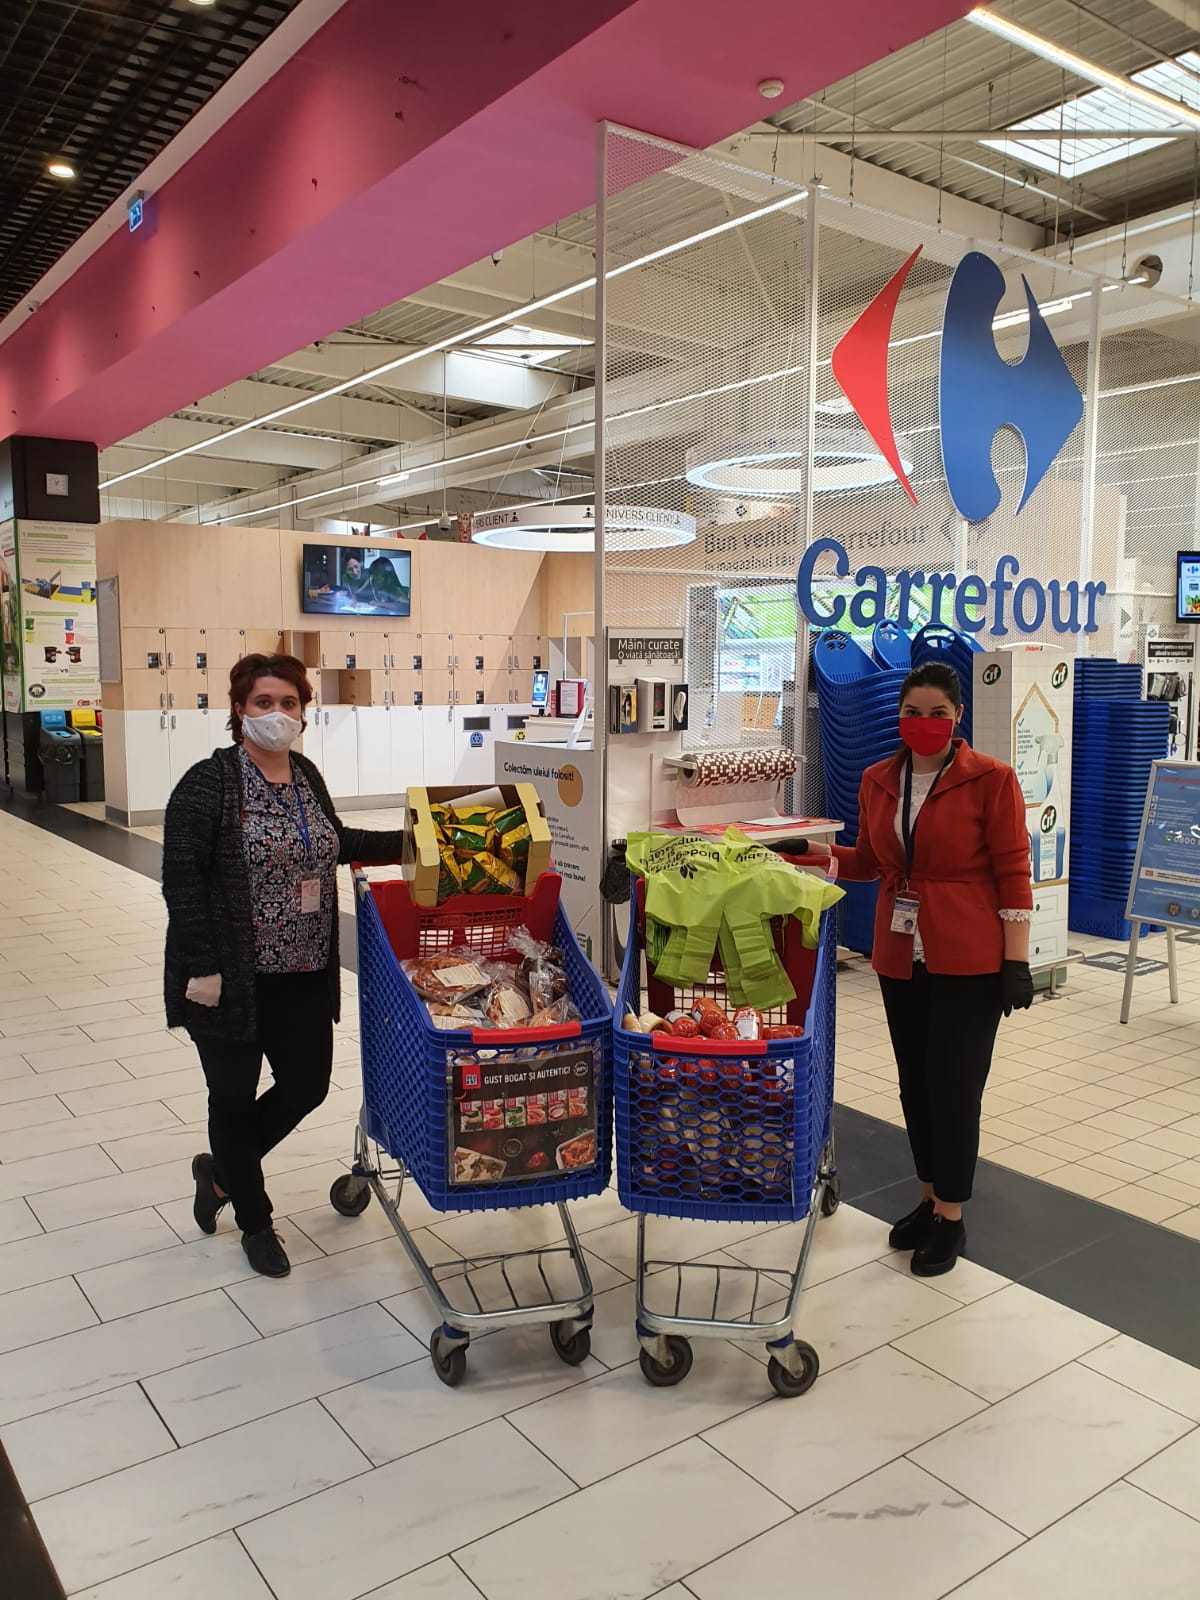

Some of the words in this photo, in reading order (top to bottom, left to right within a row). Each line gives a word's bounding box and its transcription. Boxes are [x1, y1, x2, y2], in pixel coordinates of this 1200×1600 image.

[485, 513, 509, 527] CLIENT
[606, 508, 644, 521] NIVERS
[797, 537, 1106, 636] Carrefour
[618, 638, 646, 650] Mâini
[648, 639, 680, 650] curate
[618, 651, 624, 659] O
[504, 762, 532, 775] Colectăm
[533, 765, 550, 778] uleiul
[551, 768, 574, 781] folosit!
[483, 1074, 503, 1086] GUST
[504, 1072, 528, 1084] BOGAT
[537, 1066, 570, 1079] AUTENTIC!
